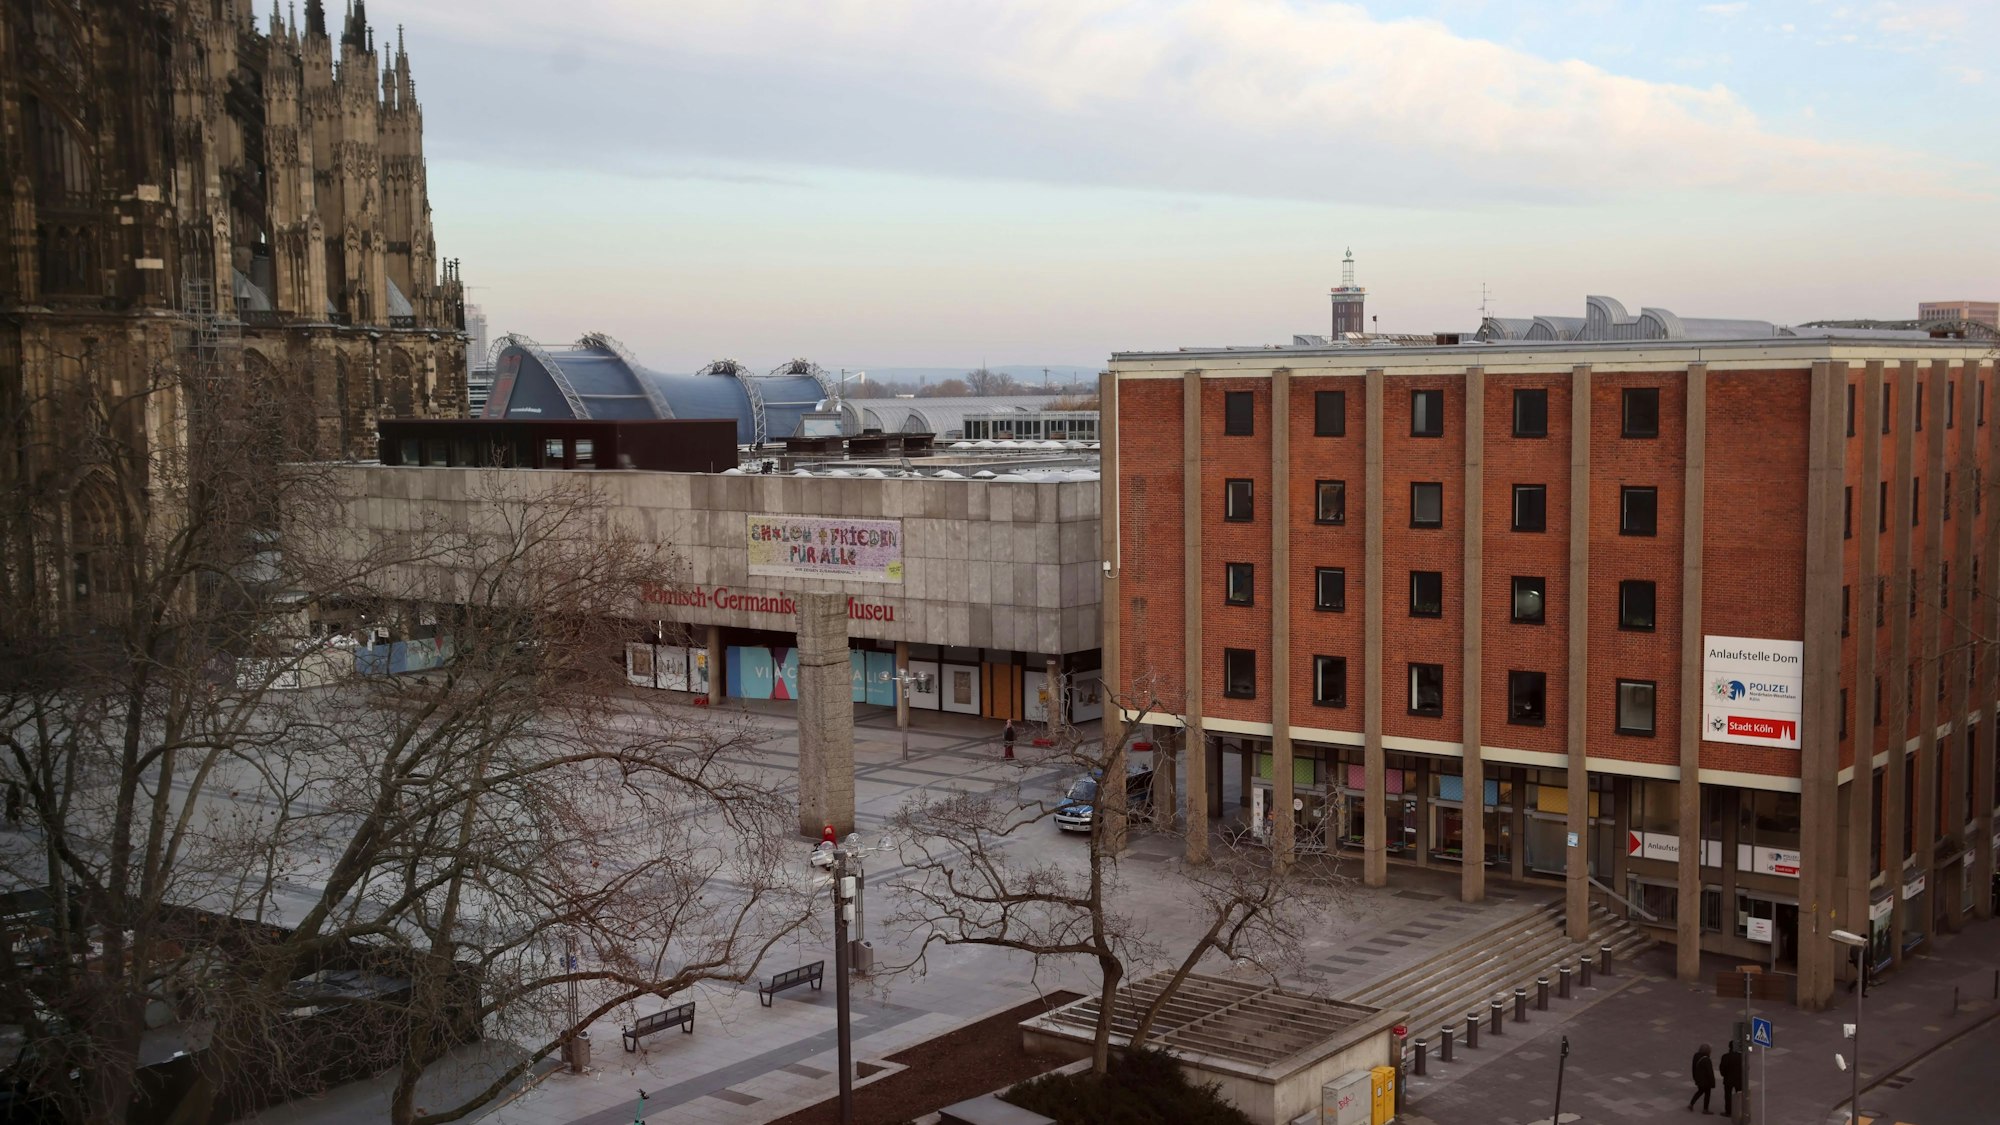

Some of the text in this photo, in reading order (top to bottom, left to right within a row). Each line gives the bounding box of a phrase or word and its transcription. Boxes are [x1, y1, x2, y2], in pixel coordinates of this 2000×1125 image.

[830, 526, 898, 547] FRIEDEN
[820, 547, 856, 565] ALLE
[1709, 648, 1798, 663] Anlaufstelle Dom
[1749, 682, 1789, 693] POLIZEI
[1729, 721, 1774, 733] Stadt Köln
